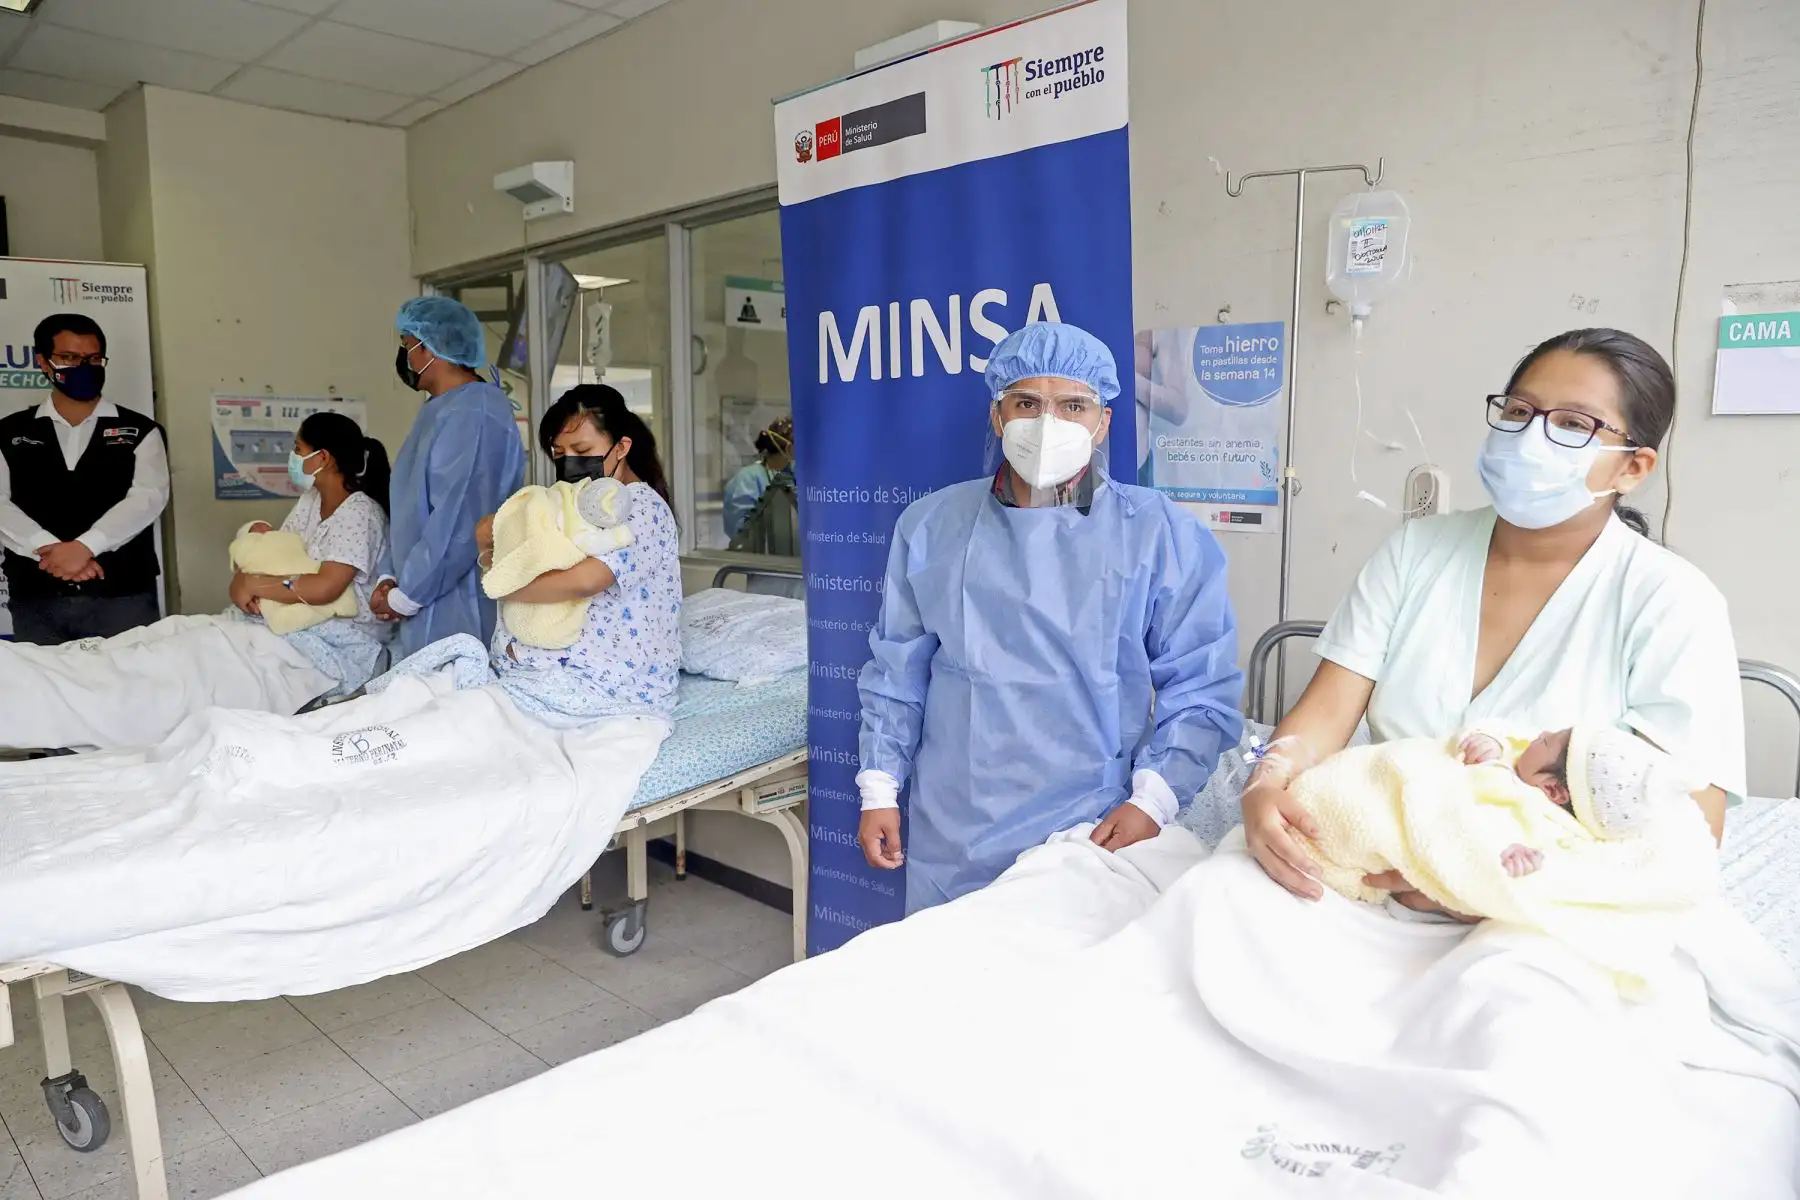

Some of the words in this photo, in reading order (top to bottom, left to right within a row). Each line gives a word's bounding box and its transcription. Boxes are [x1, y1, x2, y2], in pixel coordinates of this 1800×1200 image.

[1025, 46, 1104, 81] Siempre
[1025, 91, 1041, 99] con
[1043, 84, 1052, 95] el
[1053, 67, 1105, 99] pueblo
[845, 121, 878, 136] Ministerio
[818, 130, 838, 147] PERÚ
[845, 137, 853, 146] de
[853, 132, 872, 144] Salud
[82, 282, 133, 295] Siempre
[101, 294, 134, 304] pueblo
[1729, 320, 1791, 341] CAMA
[1200, 345, 1223, 354] Toma
[1225, 335, 1279, 352] hierro
[1212, 355, 1249, 367] pastillas
[1250, 355, 1277, 364] desde
[1201, 370, 1211, 380] la
[1214, 370, 1260, 380] semana
[1263, 367, 1276, 379] 14
[1157, 436, 1204, 448] Gestantes
[1208, 439, 1221, 448] sin
[1225, 439, 1264, 450] anemia,
[1167, 451, 1196, 462] bebés
[1199, 454, 1219, 462] con
[1223, 451, 1257, 462] futuro
[806, 486, 870, 503] Ministerio
[873, 486, 889, 503] de
[1177, 491, 1201, 499] segura
[1202, 491, 1207, 500] y
[1208, 491, 1246, 500] voluntaria
[807, 531, 844, 543] Ministerio
[846, 531, 860, 543] de
[862, 532, 886, 544] Salud
[808, 573, 872, 593] Ministerio
[809, 618, 848, 631] Ministerio
[850, 620, 863, 632] de
[808, 705, 852, 720] Ministerio
[810, 785, 855, 802] Ministerio
[812, 864, 858, 884] Ministerio
[859, 877, 869, 889] de
[871, 880, 895, 896] Salud
